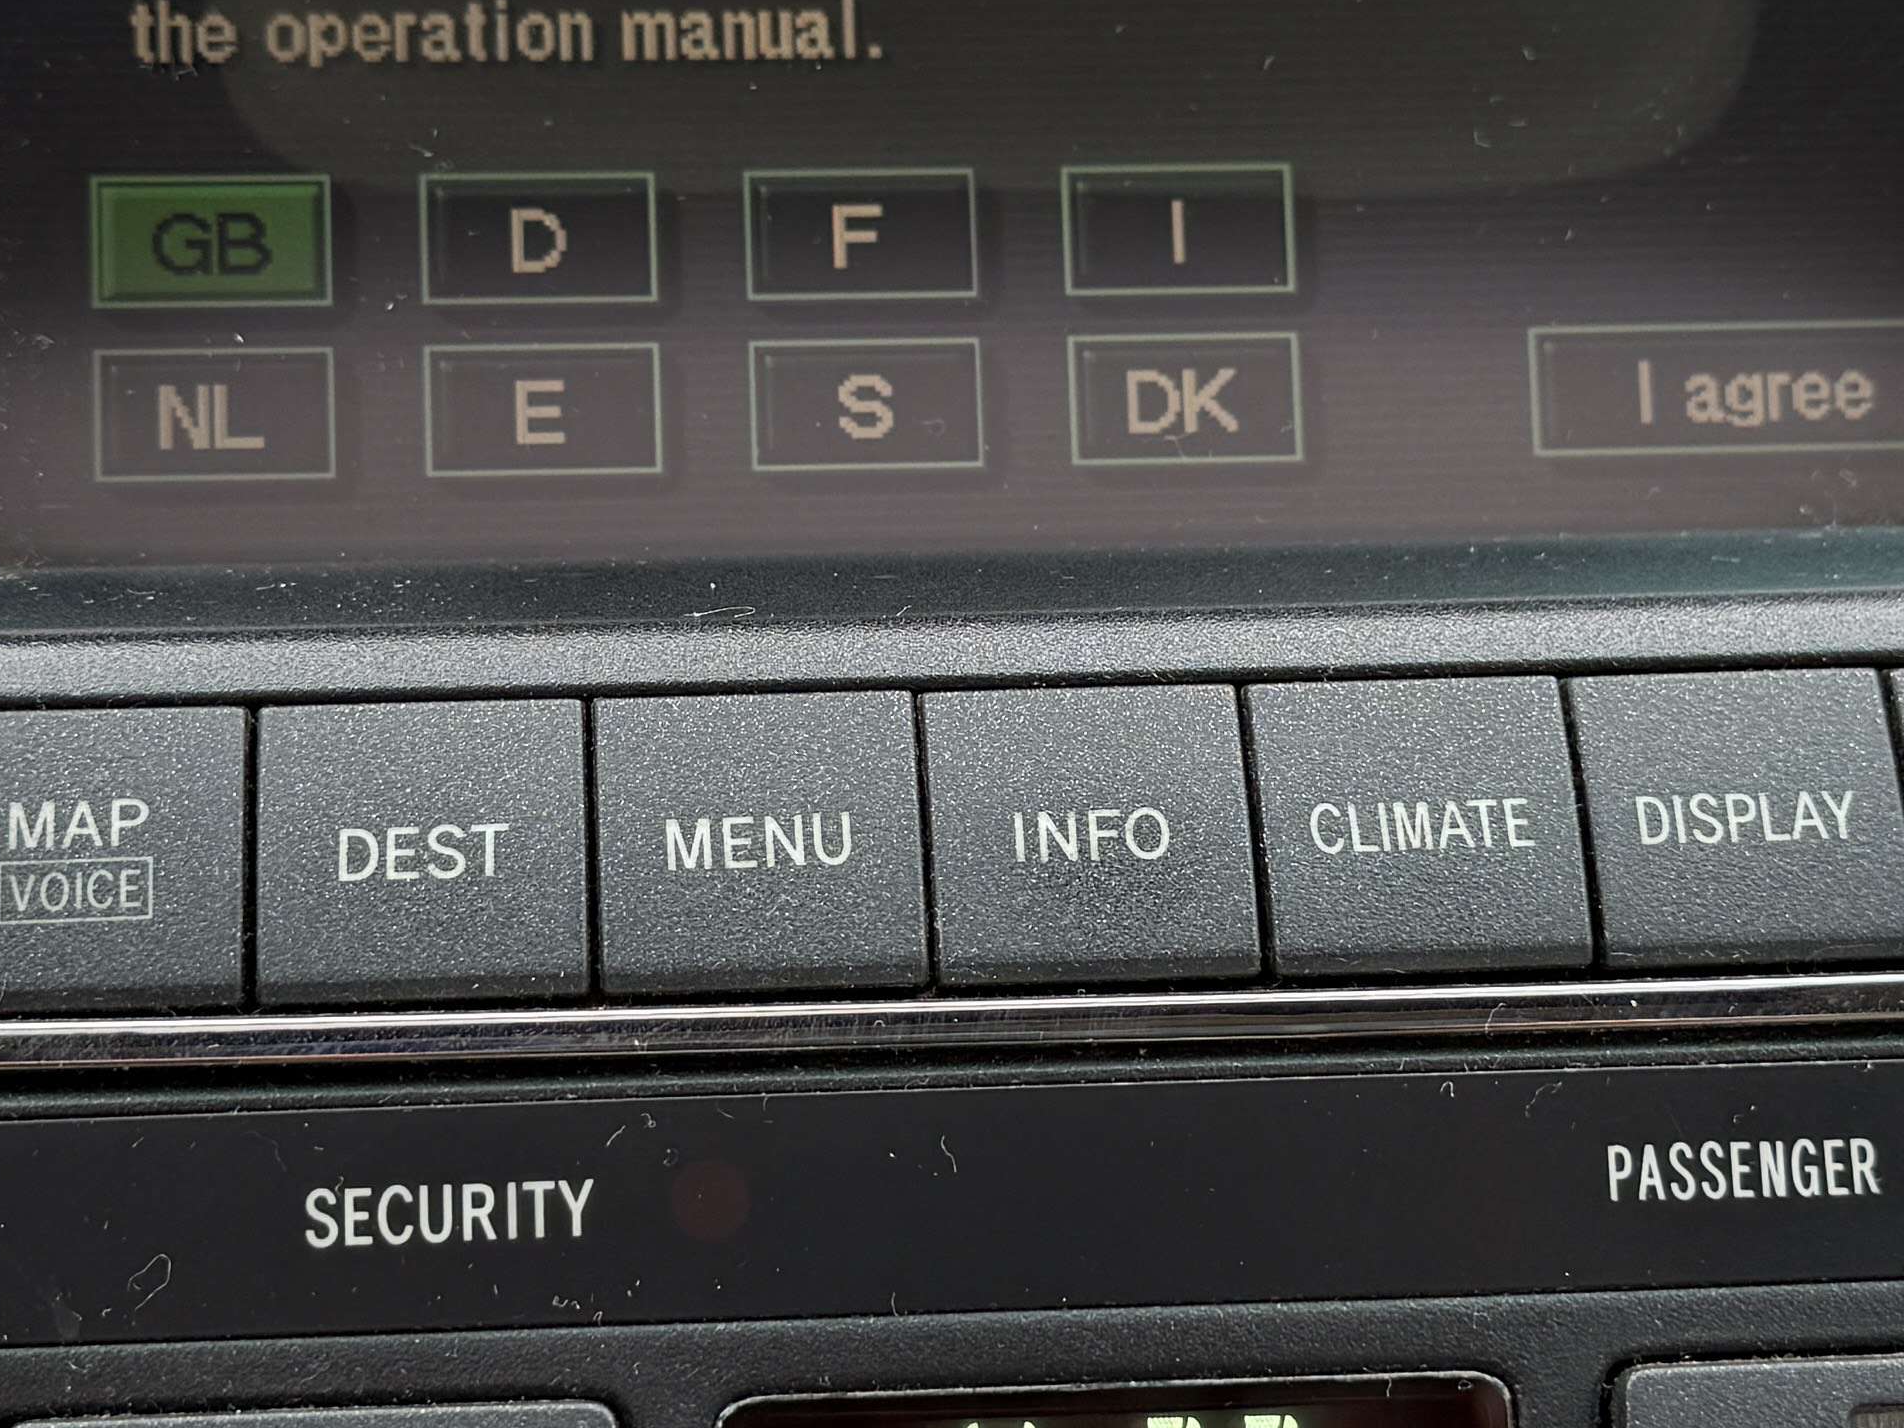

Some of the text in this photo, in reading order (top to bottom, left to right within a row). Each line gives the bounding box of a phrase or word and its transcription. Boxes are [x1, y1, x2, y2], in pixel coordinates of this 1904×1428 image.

[130, 0, 238, 65] the
[151, 210, 274, 279] GB
[509, 207, 568, 274] D
[831, 203, 884, 270] F
[1170, 198, 1186, 264] I
[157, 383, 265, 452] NL
[514, 378, 566, 446] E
[836, 372, 894, 440] S
[1124, 366, 1240, 435] DK
[1637, 360, 1873, 429] I agree
[6, 797, 151, 851] MAP
[336, 821, 510, 883] DEST
[664, 811, 854, 872] MENU
[1012, 807, 1172, 864] INFO
[1308, 797, 1537, 855] CLIMATE
[1634, 790, 1856, 847] DISPLAY
[10, 866, 143, 915] VOICE
[1606, 1137, 1881, 1205] PASSENGER
[303, 1179, 595, 1248] SECURITY
